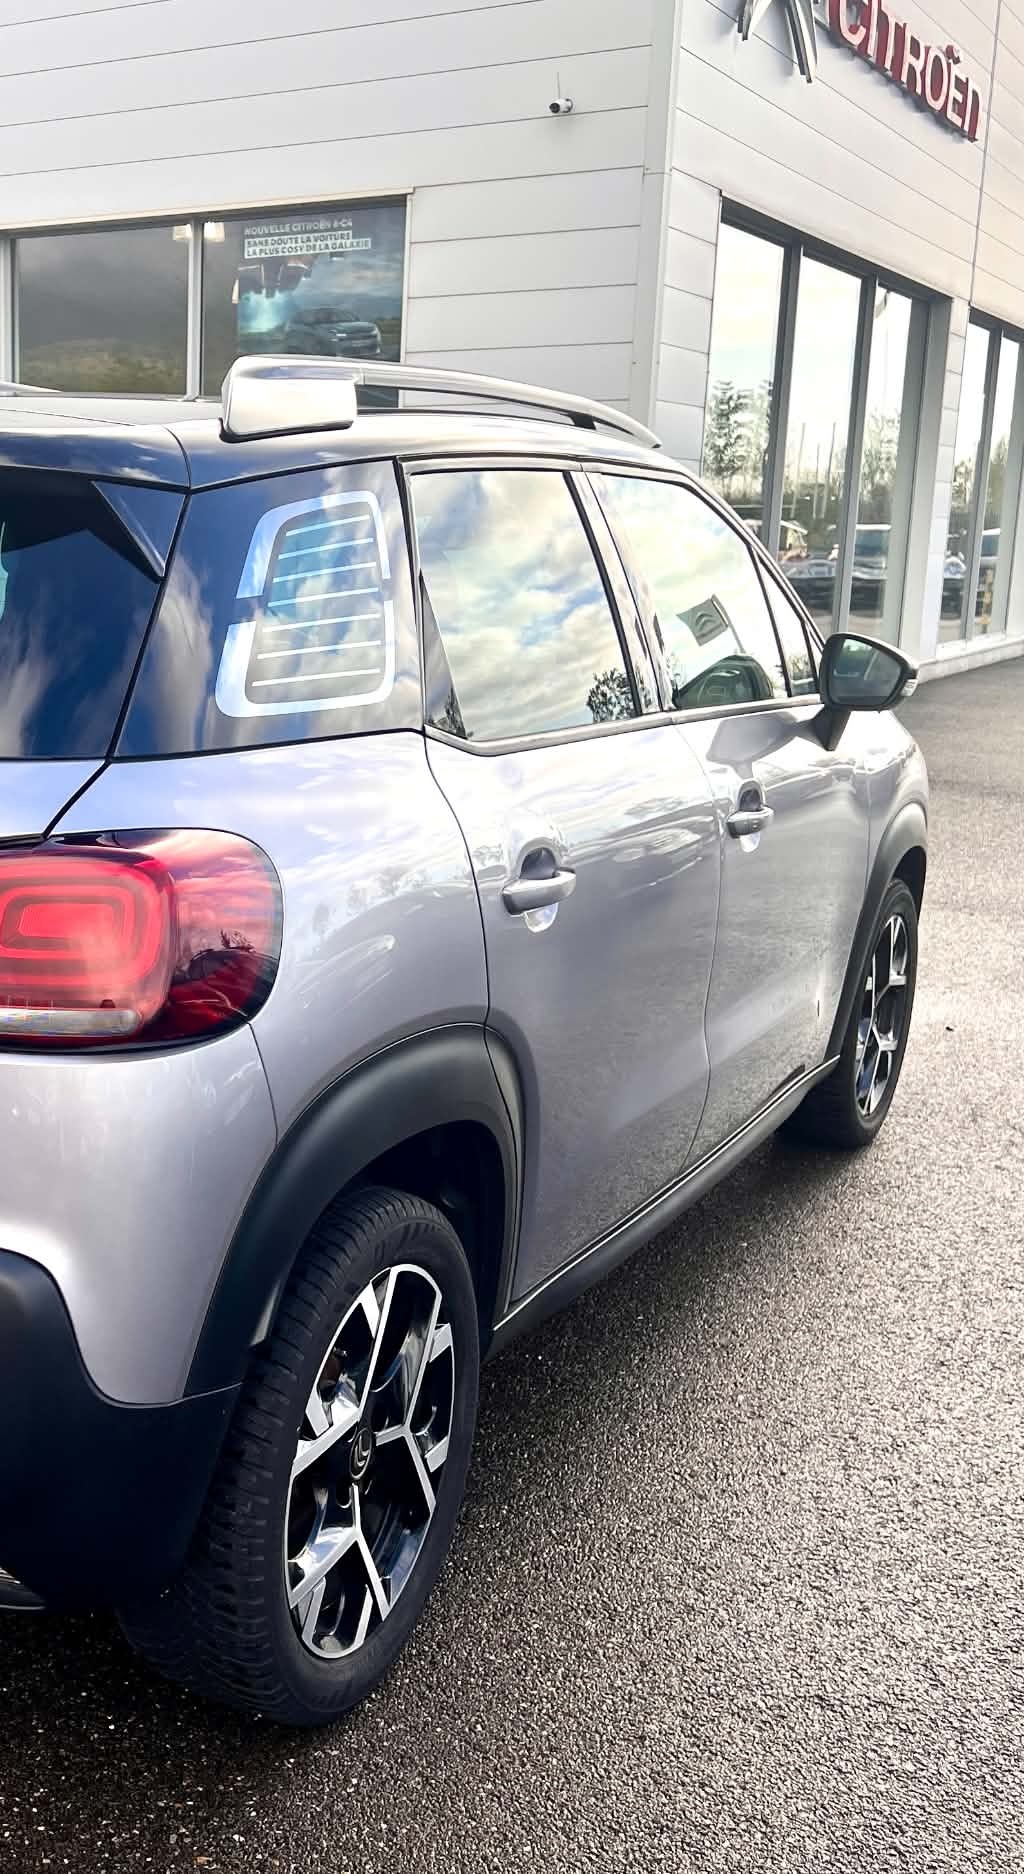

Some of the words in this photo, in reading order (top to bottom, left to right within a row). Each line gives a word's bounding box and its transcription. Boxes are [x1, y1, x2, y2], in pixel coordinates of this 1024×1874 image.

[244, 224, 290, 234] NOUVELLE
[271, 237, 299, 245] DOUTE
[301, 235, 312, 243] LA
[312, 232, 351, 242] VOITURE
[247, 248, 257, 256] LA
[259, 247, 280, 255] PLUS
[281, 245, 303, 254] COSY
[305, 244, 317, 252] DE
[319, 243, 330, 251] LA
[331, 240, 369, 250] GALAXIE
